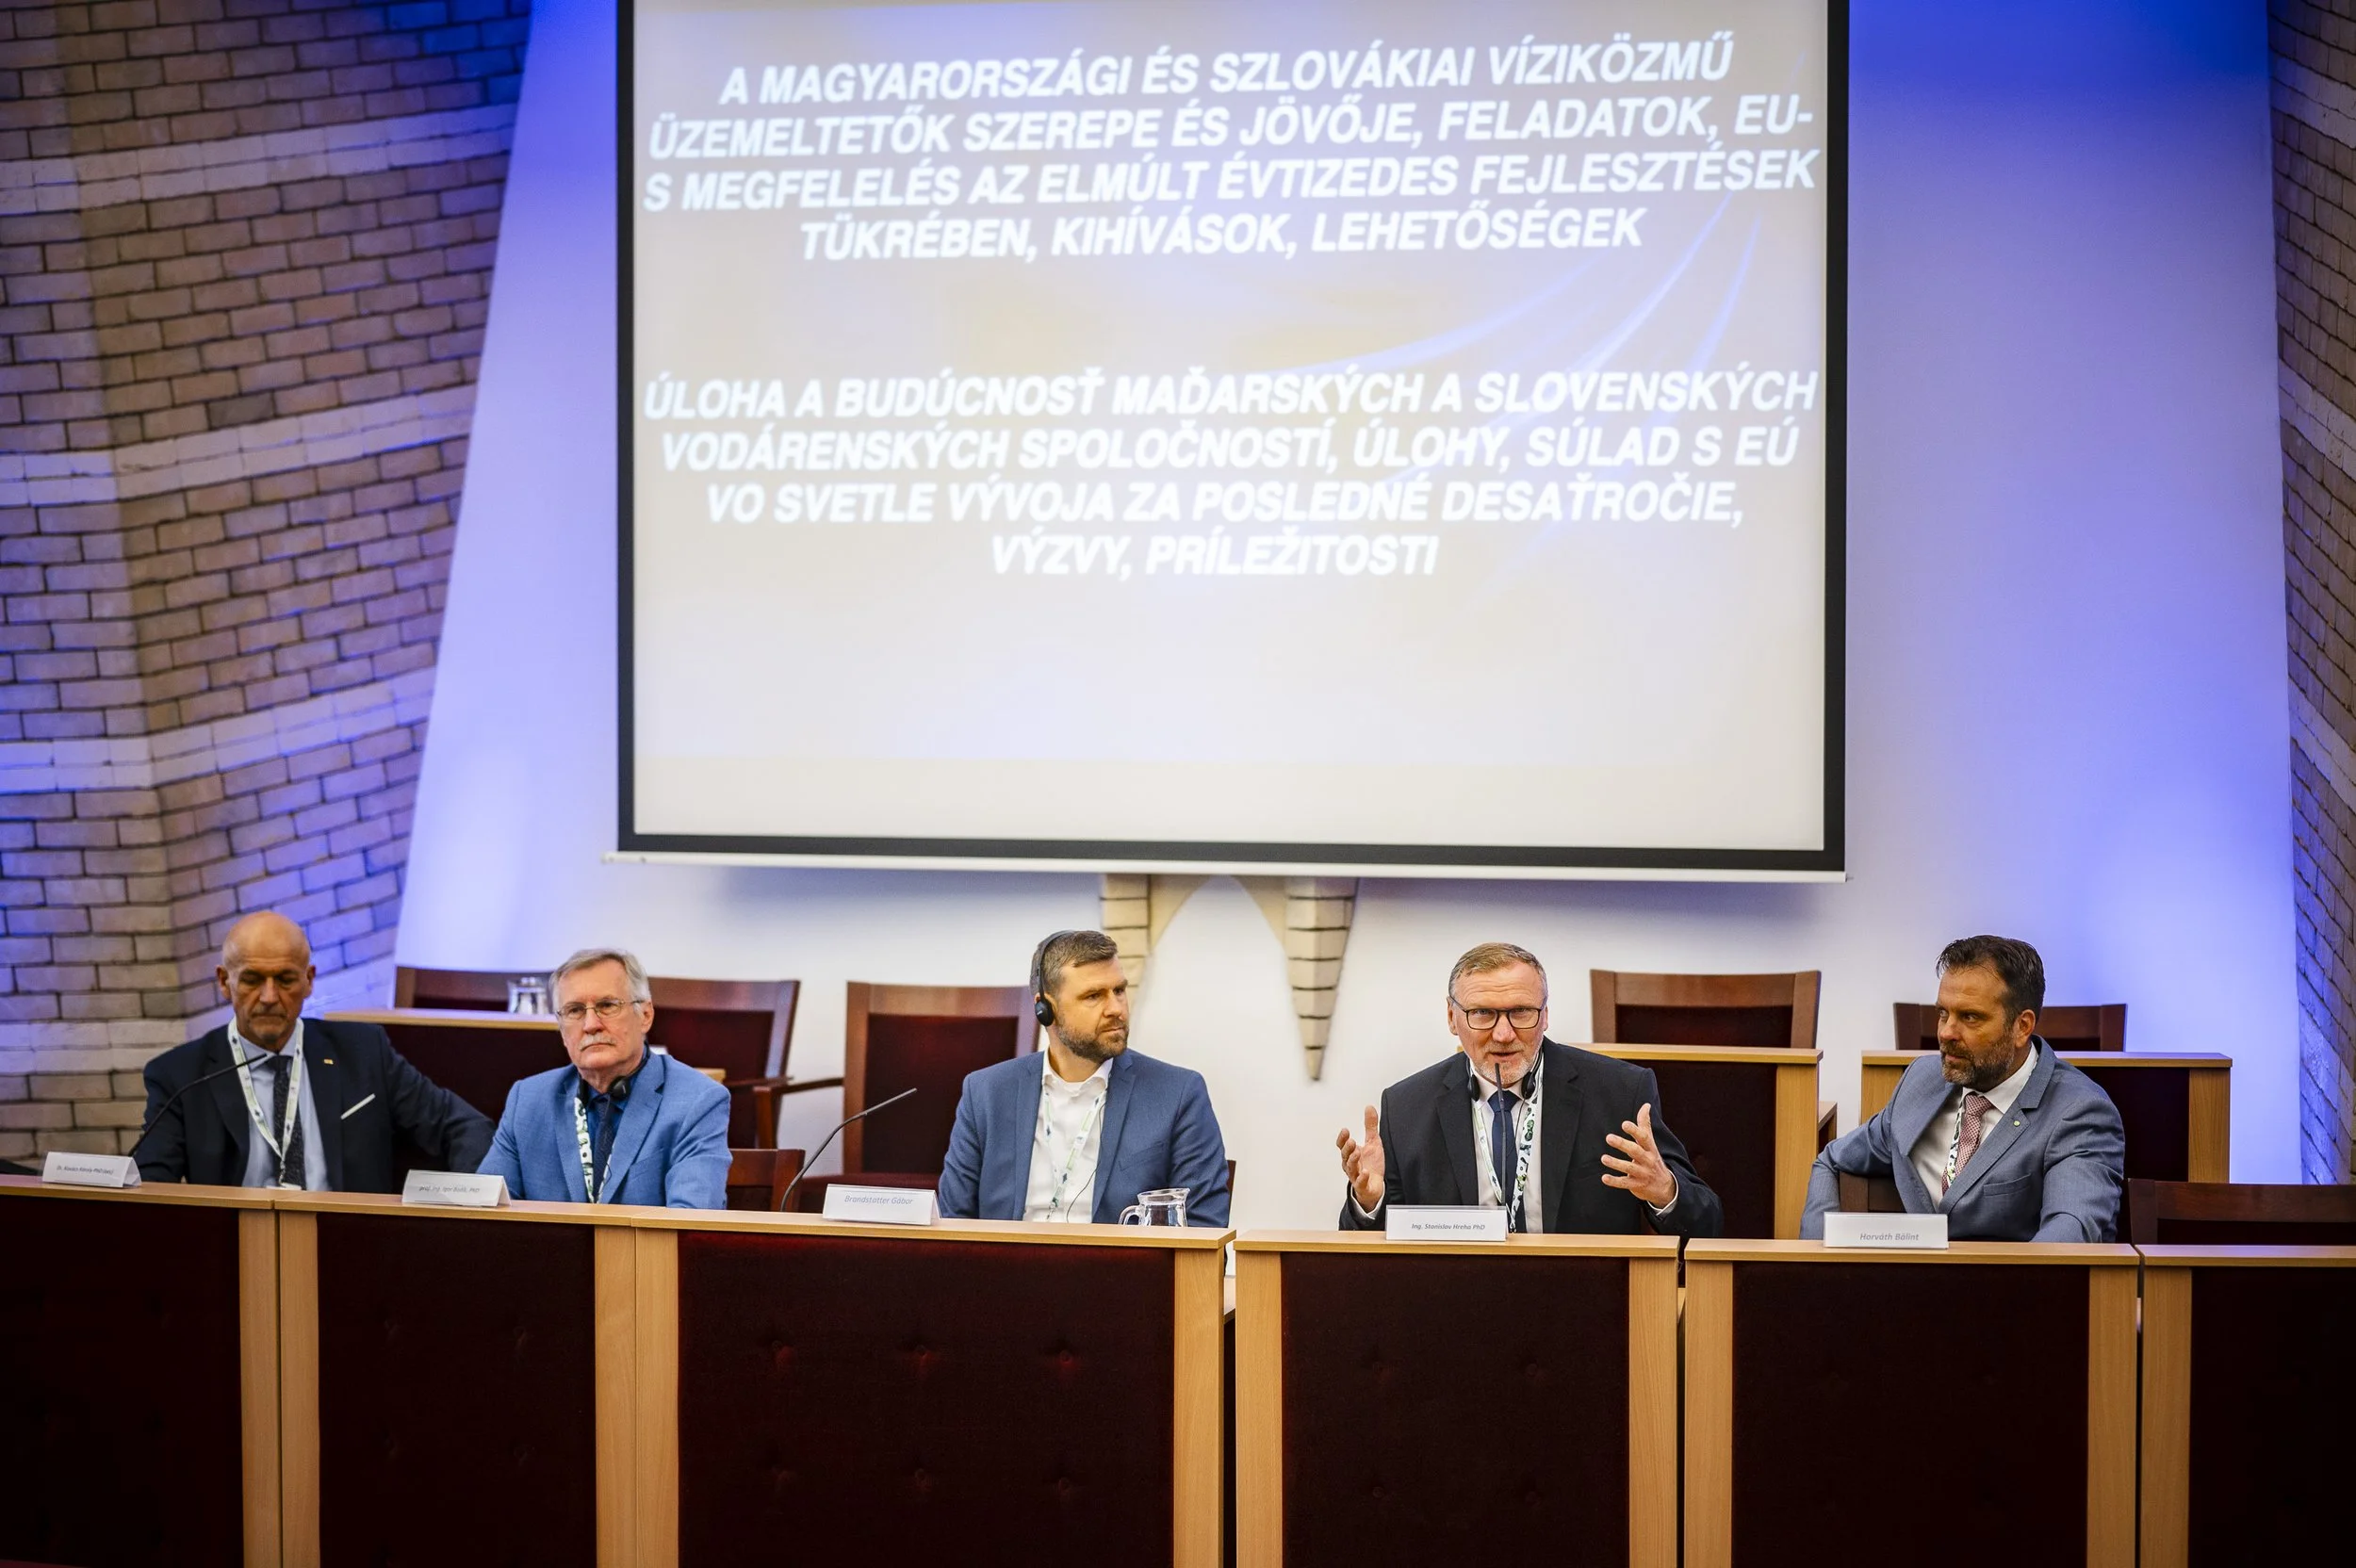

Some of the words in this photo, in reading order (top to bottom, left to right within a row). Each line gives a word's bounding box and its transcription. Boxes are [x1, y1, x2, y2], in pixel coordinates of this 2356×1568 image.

[719, 67, 749, 105] A
[760, 47, 1133, 104] MAGYARORSZÁGI
[1141, 46, 1199, 94] ÉS
[1210, 40, 1475, 93] SZLOVÁKIAI
[1490, 31, 1734, 85] VÍZIKÖZMŰ
[649, 105, 956, 159] ÜZEMELTETŐK
[963, 109, 1163, 152] SZEREPE
[1171, 99, 1229, 147] ÉS
[1239, 94, 1423, 149] JÖVŐJE,
[1438, 96, 1722, 142] FELADATOK,
[1735, 94, 1813, 135] EU-
[643, 172, 672, 212] S
[682, 159, 961, 210] MEGFELELÉS
[968, 164, 1030, 204] AZ
[1037, 153, 1209, 204] ELMÚLT
[1217, 151, 1460, 200] ÉVTIZEDES
[1470, 142, 1821, 195] FEJLESZTÉSEK
[801, 212, 1038, 263] TÜKRÉBEN,
[1051, 203, 1298, 259] KIHÍVÁSOK,
[1311, 199, 1647, 253] LEHETŐSÉGEK
[644, 372, 786, 419] ÚLOHA
[794, 379, 824, 417] A
[834, 368, 1104, 418] BUDÚCNOSŤ
[1111, 364, 1425, 416] MAĎARSKÝCH
[1431, 373, 1463, 414] A
[1475, 362, 1818, 414] SLOVENSKÝCH
[663, 420, 1010, 470] VODÁRENSKÝCH
[1018, 418, 1338, 473] SPOLOČNOSTÍ,
[1353, 417, 1510, 472] ÚLOHY,
[1525, 417, 1680, 466] SÚLAD
[1693, 425, 1723, 466] S
[1735, 417, 1800, 466] EÚ
[707, 483, 765, 523] VO
[773, 482, 937, 523] SVETLE
[948, 473, 1114, 522] VÝVOJA
[1121, 482, 1182, 522] ZA
[1192, 473, 1432, 523] POSLEDNÉ
[1442, 471, 1744, 529] DESAŤROČIE,
[992, 526, 1134, 581] VÝZVY,
[1144, 525, 1440, 576] PRÍLEŽITOSTI
[1859, 1233, 1893, 1241] Horváth
[1895, 1233, 1920, 1241] Bálint
